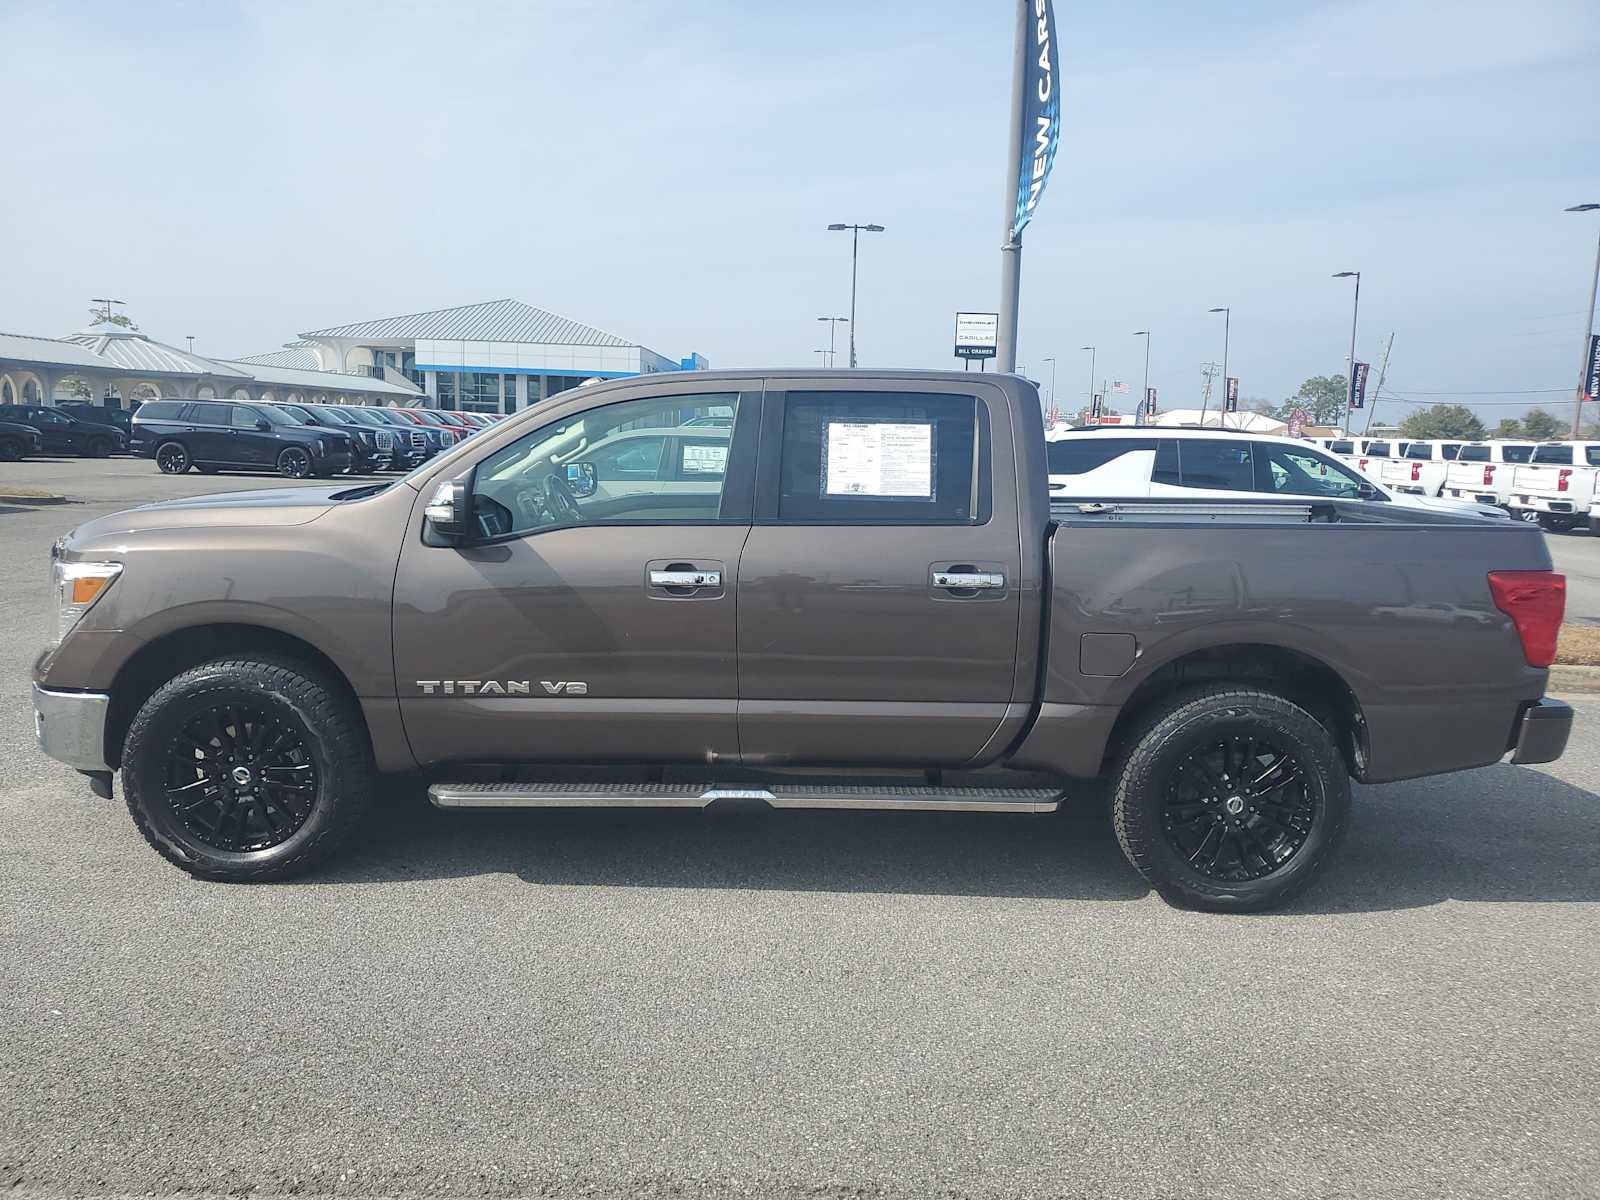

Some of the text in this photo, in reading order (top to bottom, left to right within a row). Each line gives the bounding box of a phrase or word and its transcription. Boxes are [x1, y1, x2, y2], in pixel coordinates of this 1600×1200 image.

[1027, 0, 1051, 211] NEW CARS
[1590, 376, 1599, 398] NEW
[416, 680, 588, 694] TITAN V8
